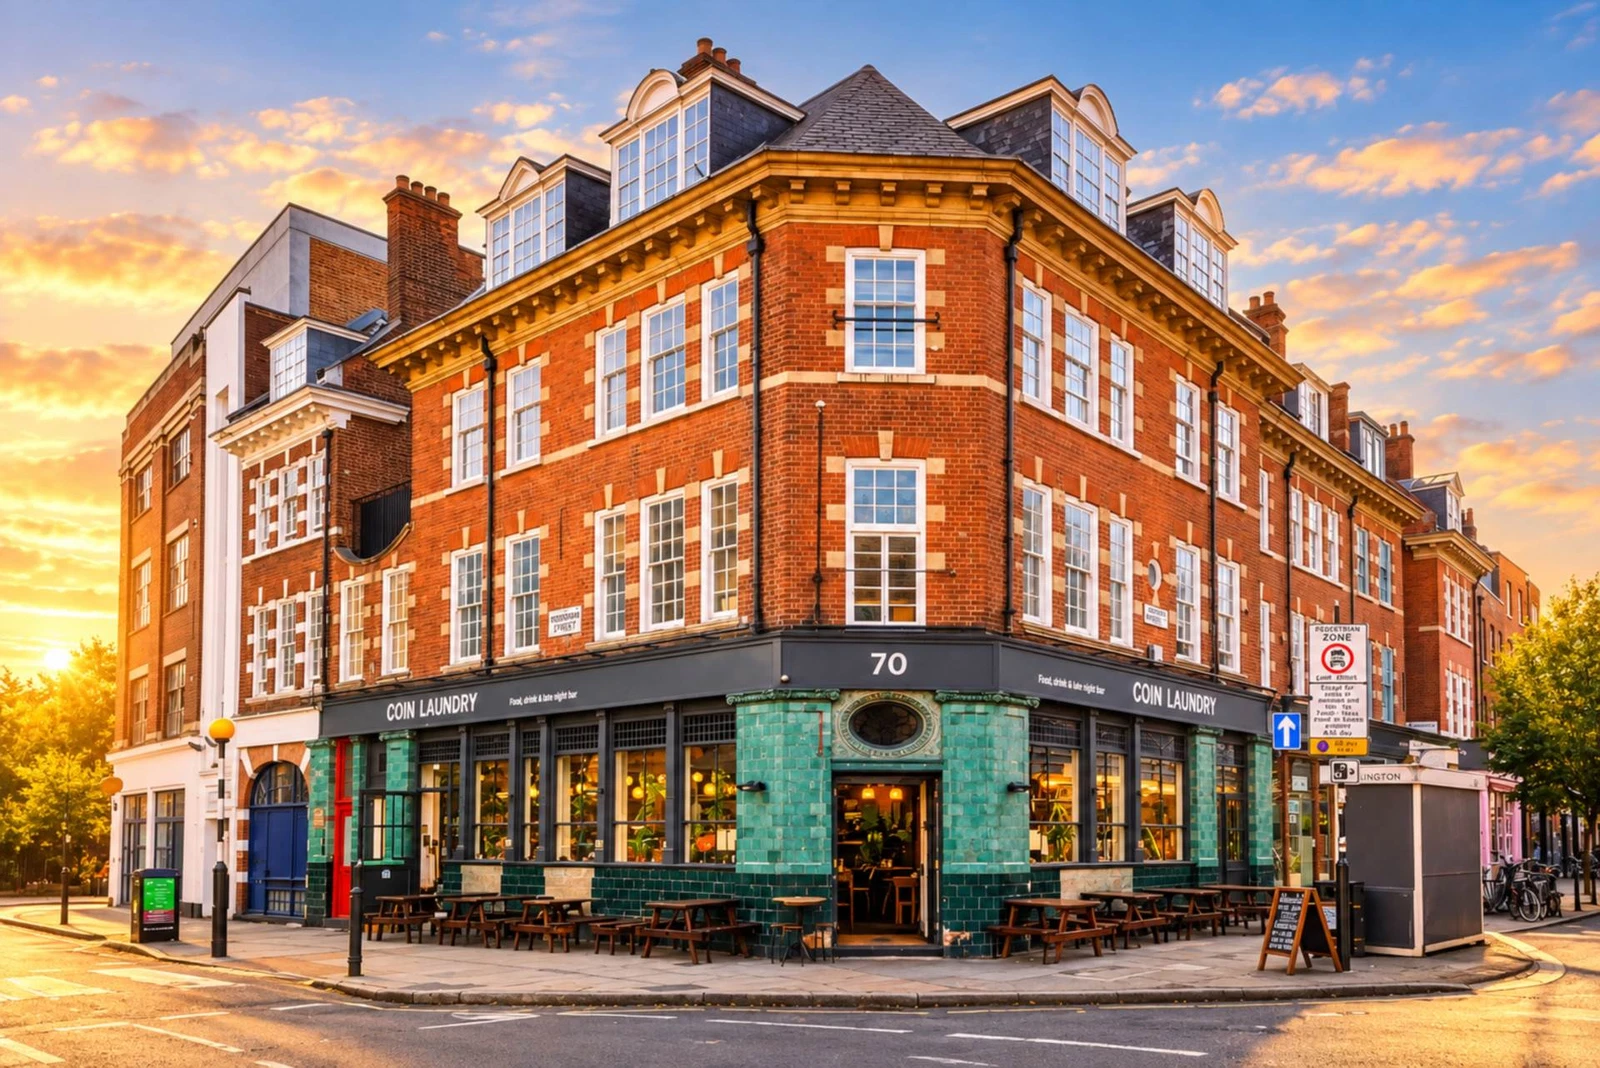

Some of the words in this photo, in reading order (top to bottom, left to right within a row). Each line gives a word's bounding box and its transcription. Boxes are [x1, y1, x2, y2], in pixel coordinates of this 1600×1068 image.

[1322, 633, 1352, 641] ZONE
[870, 652, 907, 676] 70
[386, 700, 415, 721] COIN
[419, 692, 478, 717] LAUNDRY
[523, 694, 537, 705] drink
[542, 693, 553, 702] late
[568, 690, 578, 699] bar
[1132, 681, 1162, 706] COIN
[1167, 688, 1217, 716] LAUNDRY
